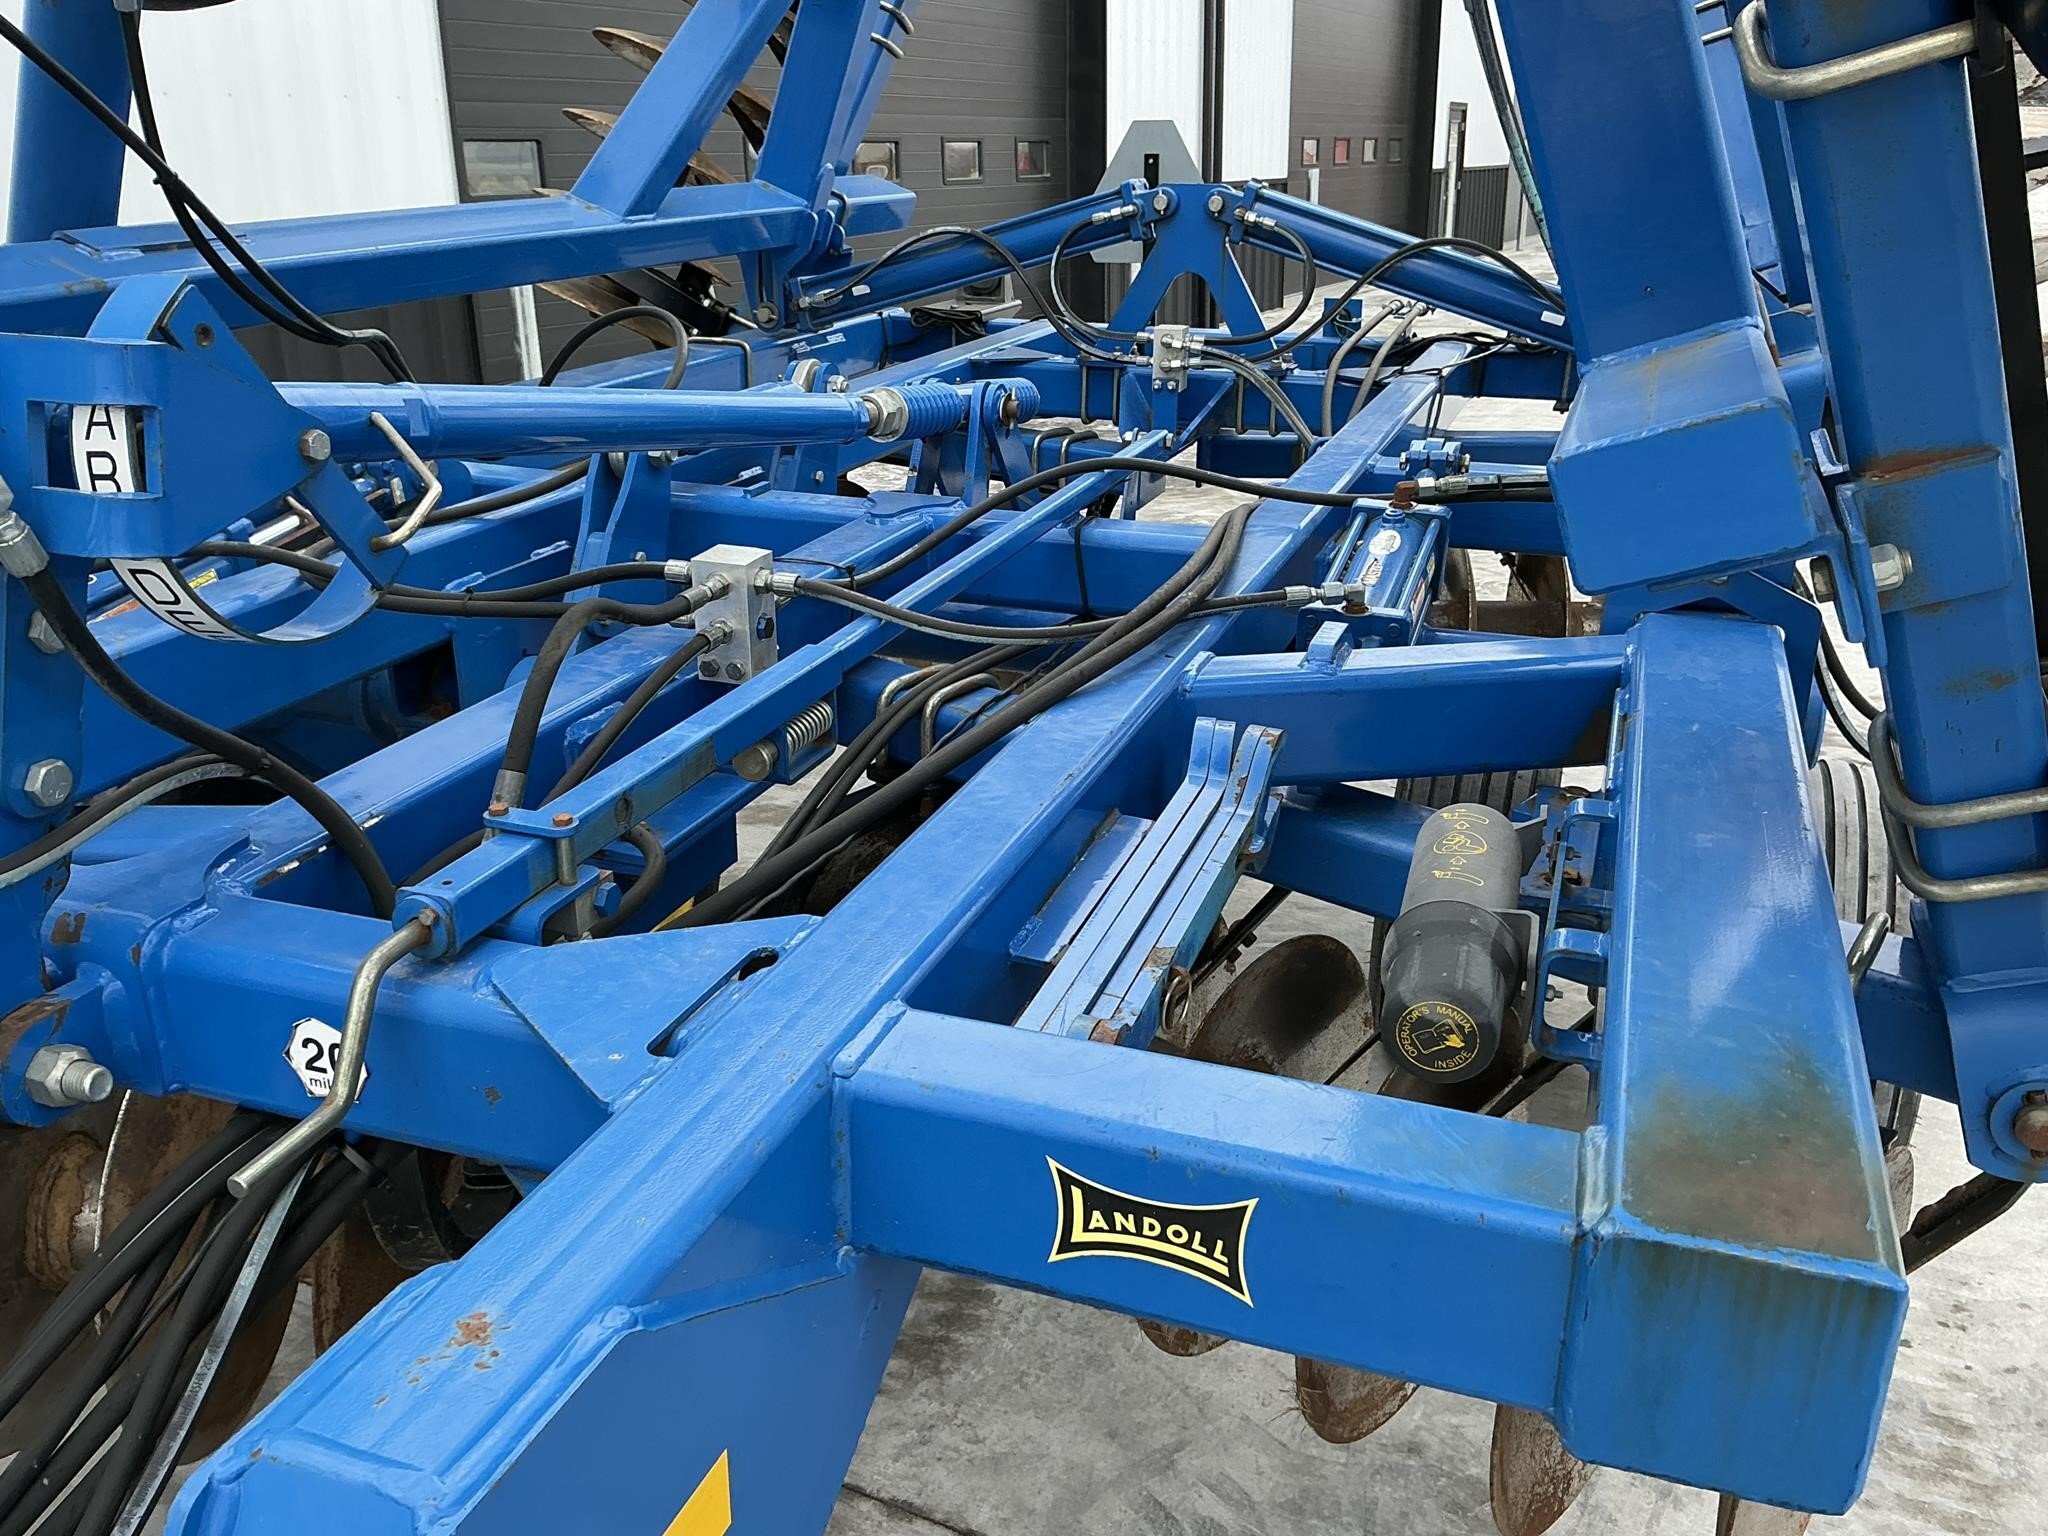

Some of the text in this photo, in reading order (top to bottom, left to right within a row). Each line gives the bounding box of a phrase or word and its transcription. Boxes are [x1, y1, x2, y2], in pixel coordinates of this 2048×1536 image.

[1401, 1005, 1473, 1057] OPERATOR'S MANUAL
[1434, 1049, 1472, 1069] INSIDE
[1069, 1184, 1231, 1278] LANDOLL
